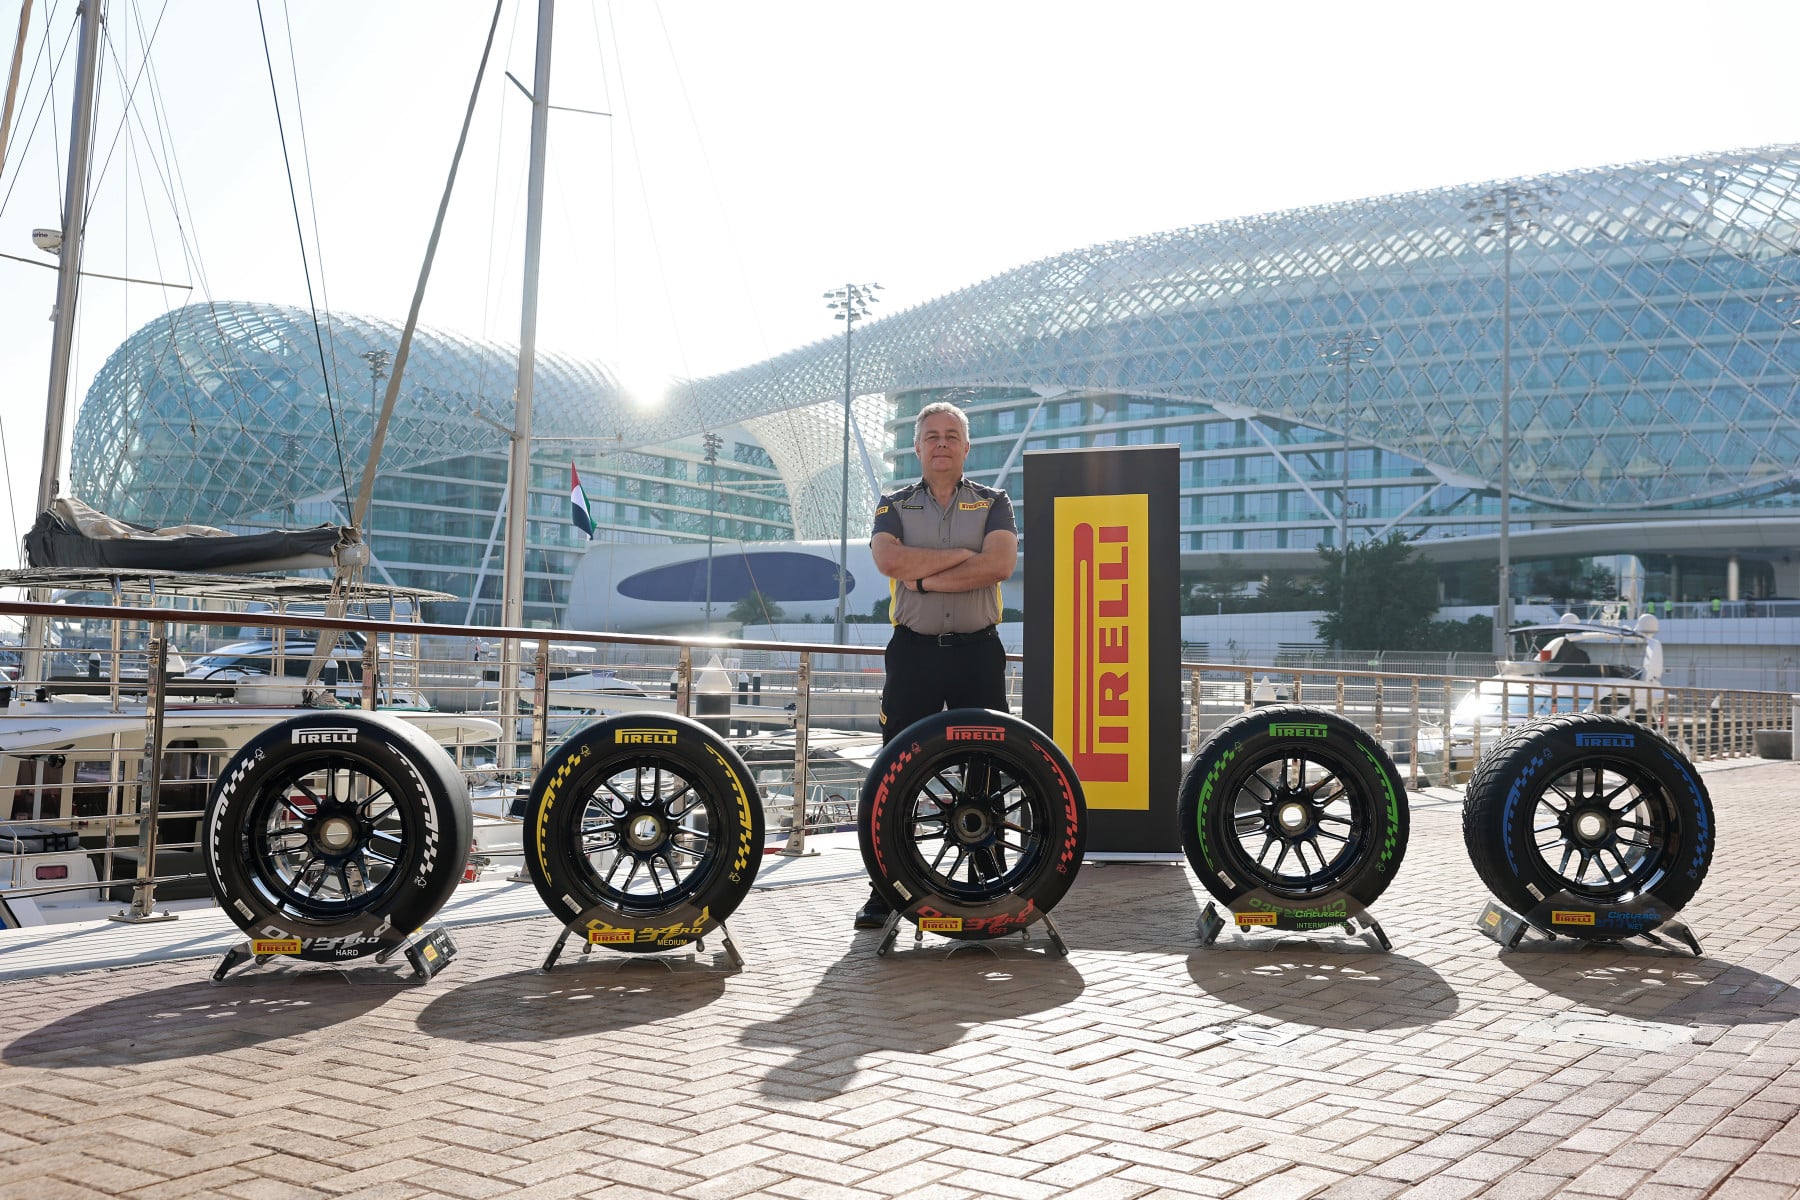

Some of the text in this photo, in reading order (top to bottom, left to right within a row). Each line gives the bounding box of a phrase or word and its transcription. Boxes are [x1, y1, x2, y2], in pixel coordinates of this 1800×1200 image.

[1073, 522, 1129, 782] PIRELLI
[292, 727, 358, 744] PIRELLI
[615, 723, 678, 744] PIRELLI
[946, 725, 1006, 741] PIRELLI
[1269, 722, 1328, 737] PIRELLI
[1575, 733, 1635, 747] PIRELLI
[1238, 914, 1273, 923] PIRELLI
[1555, 913, 1591, 922] PIRELLI
[922, 919, 958, 929] PIRELLI
[592, 932, 630, 942] PIRELLI
[256, 942, 297, 951] PIRELLI
[336, 949, 359, 957] HARD
